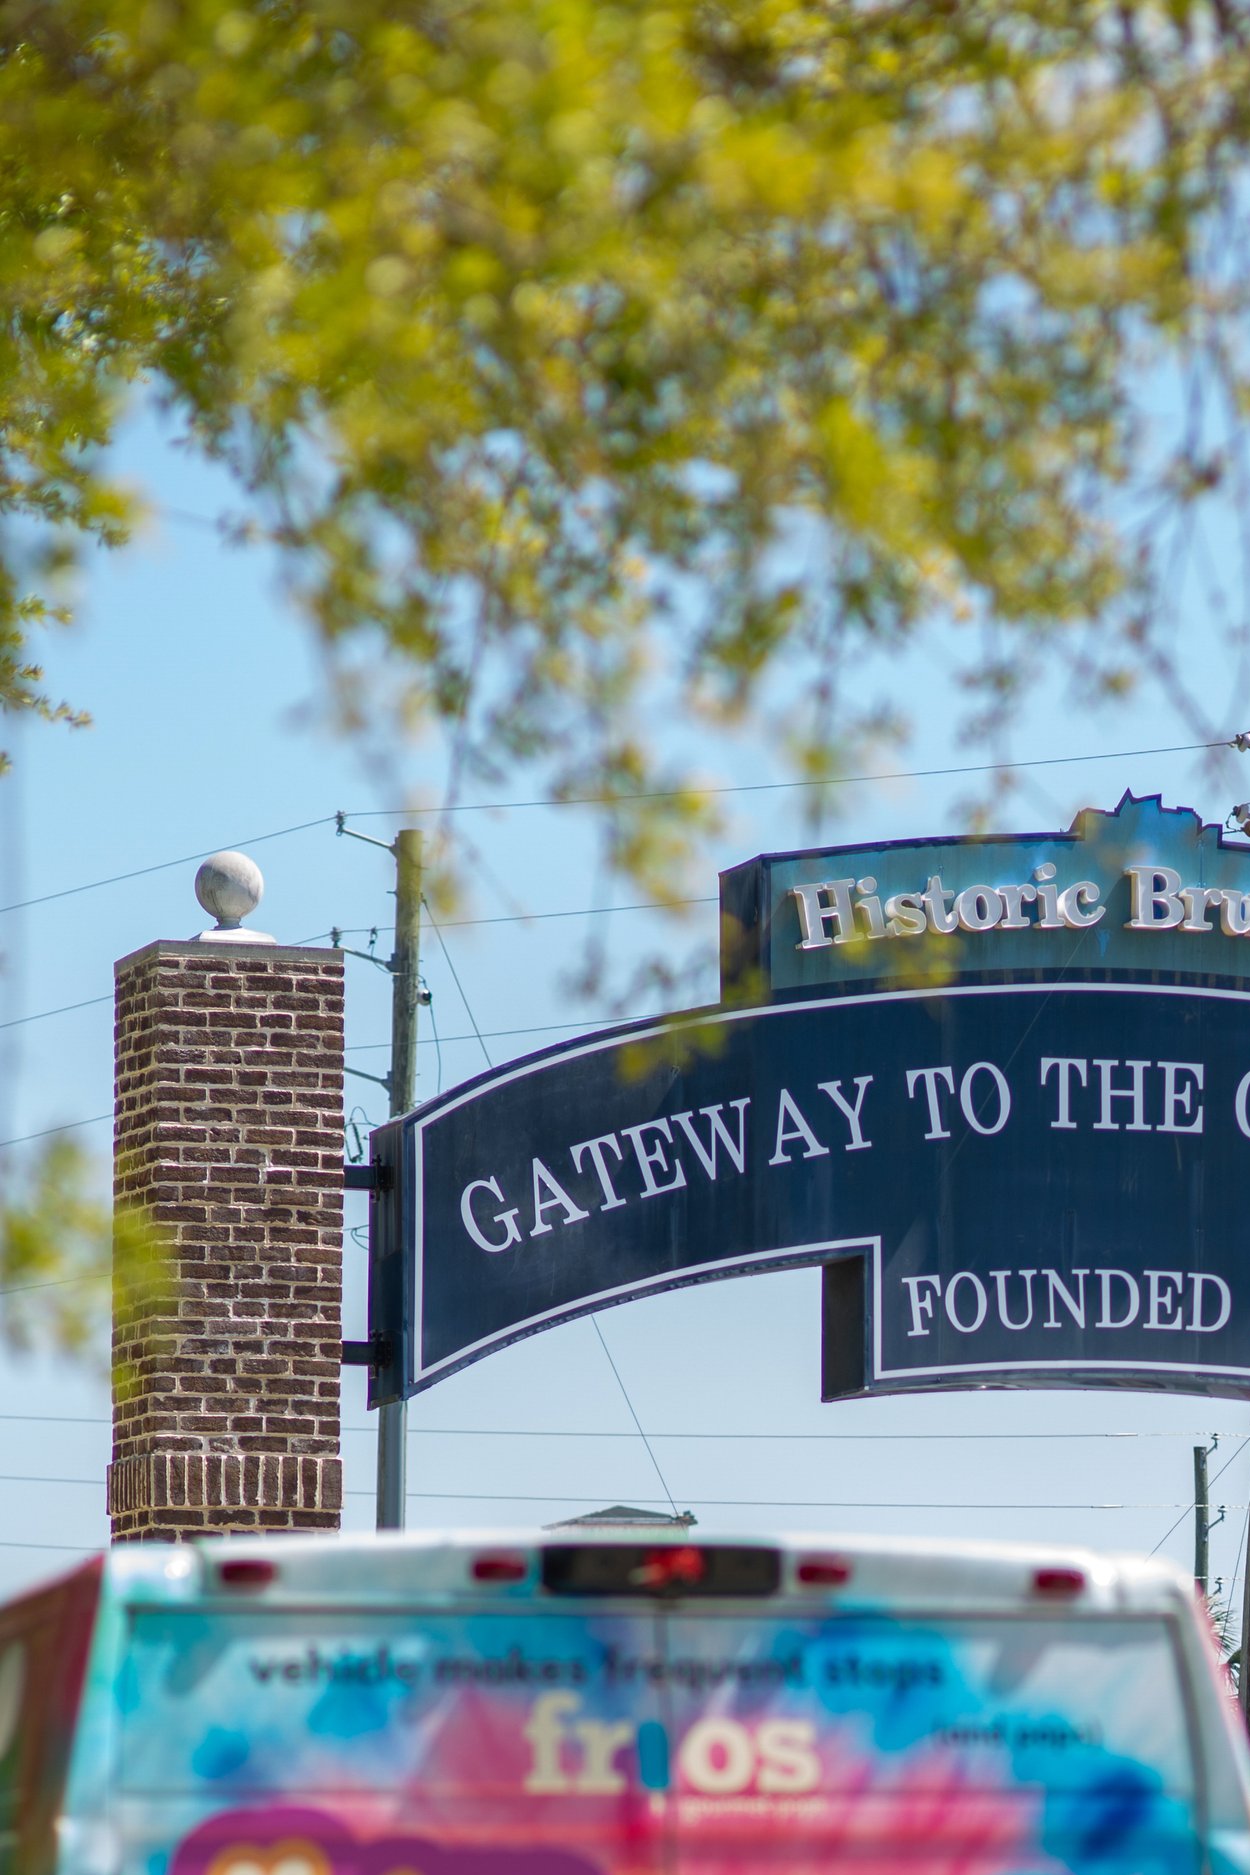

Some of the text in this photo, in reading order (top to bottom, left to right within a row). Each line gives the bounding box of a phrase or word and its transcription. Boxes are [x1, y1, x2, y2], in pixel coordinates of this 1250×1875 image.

[788, 863, 1106, 949] Historic
[460, 1076, 874, 1253] GATEWAY
[906, 1061, 1011, 1140] TO
[1040, 1057, 1204, 1133] THE
[901, 1269, 1231, 1336] FOUNDED
